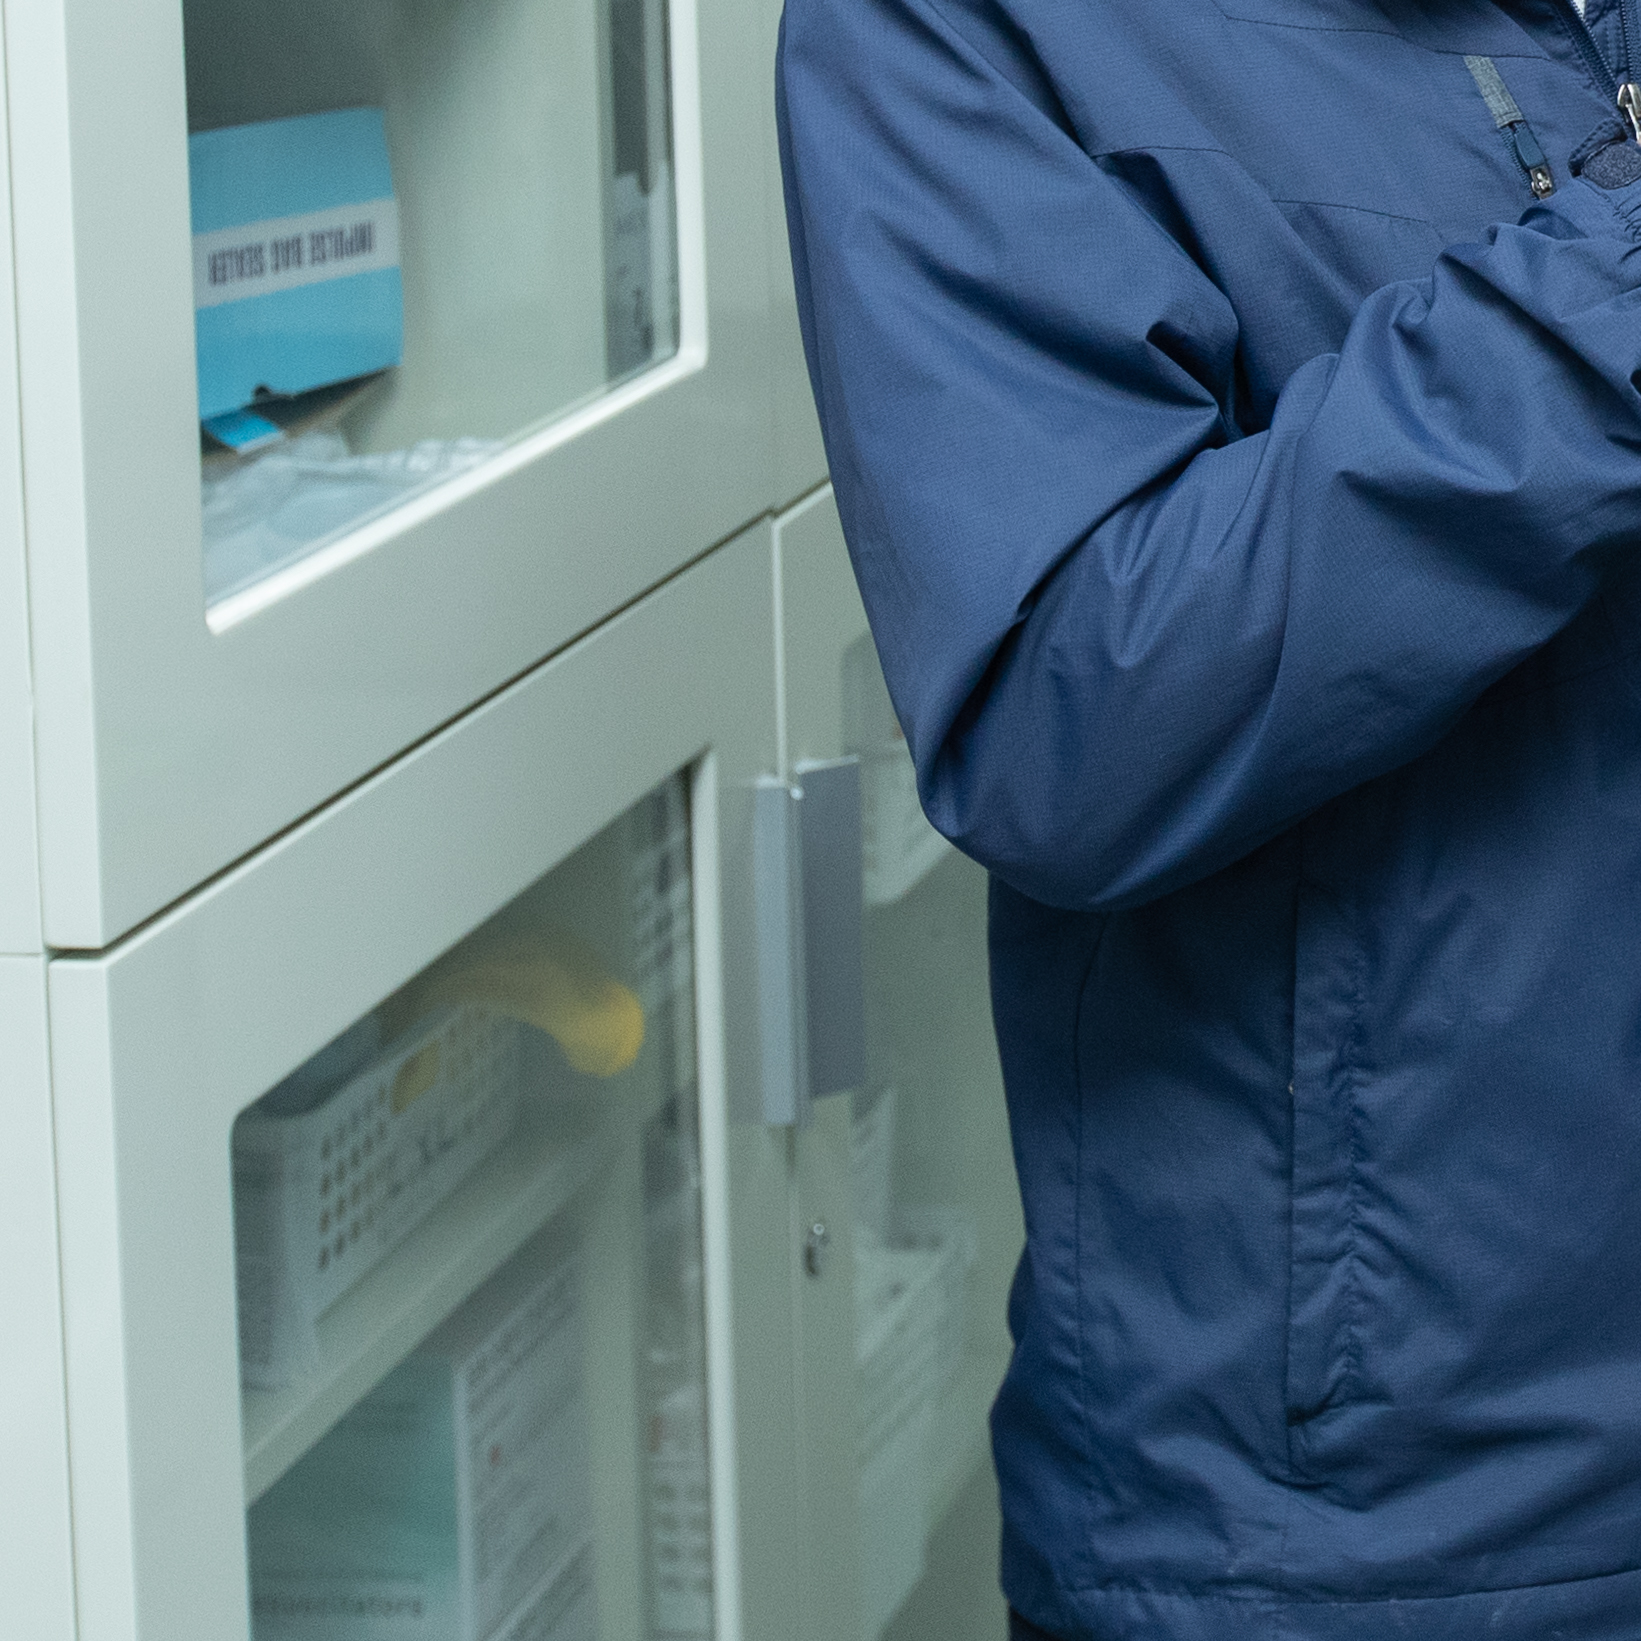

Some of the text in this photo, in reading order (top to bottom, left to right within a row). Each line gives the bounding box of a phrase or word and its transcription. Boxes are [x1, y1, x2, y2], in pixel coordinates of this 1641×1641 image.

[207, 221, 374, 287] IMPULSE BAG SEALER
